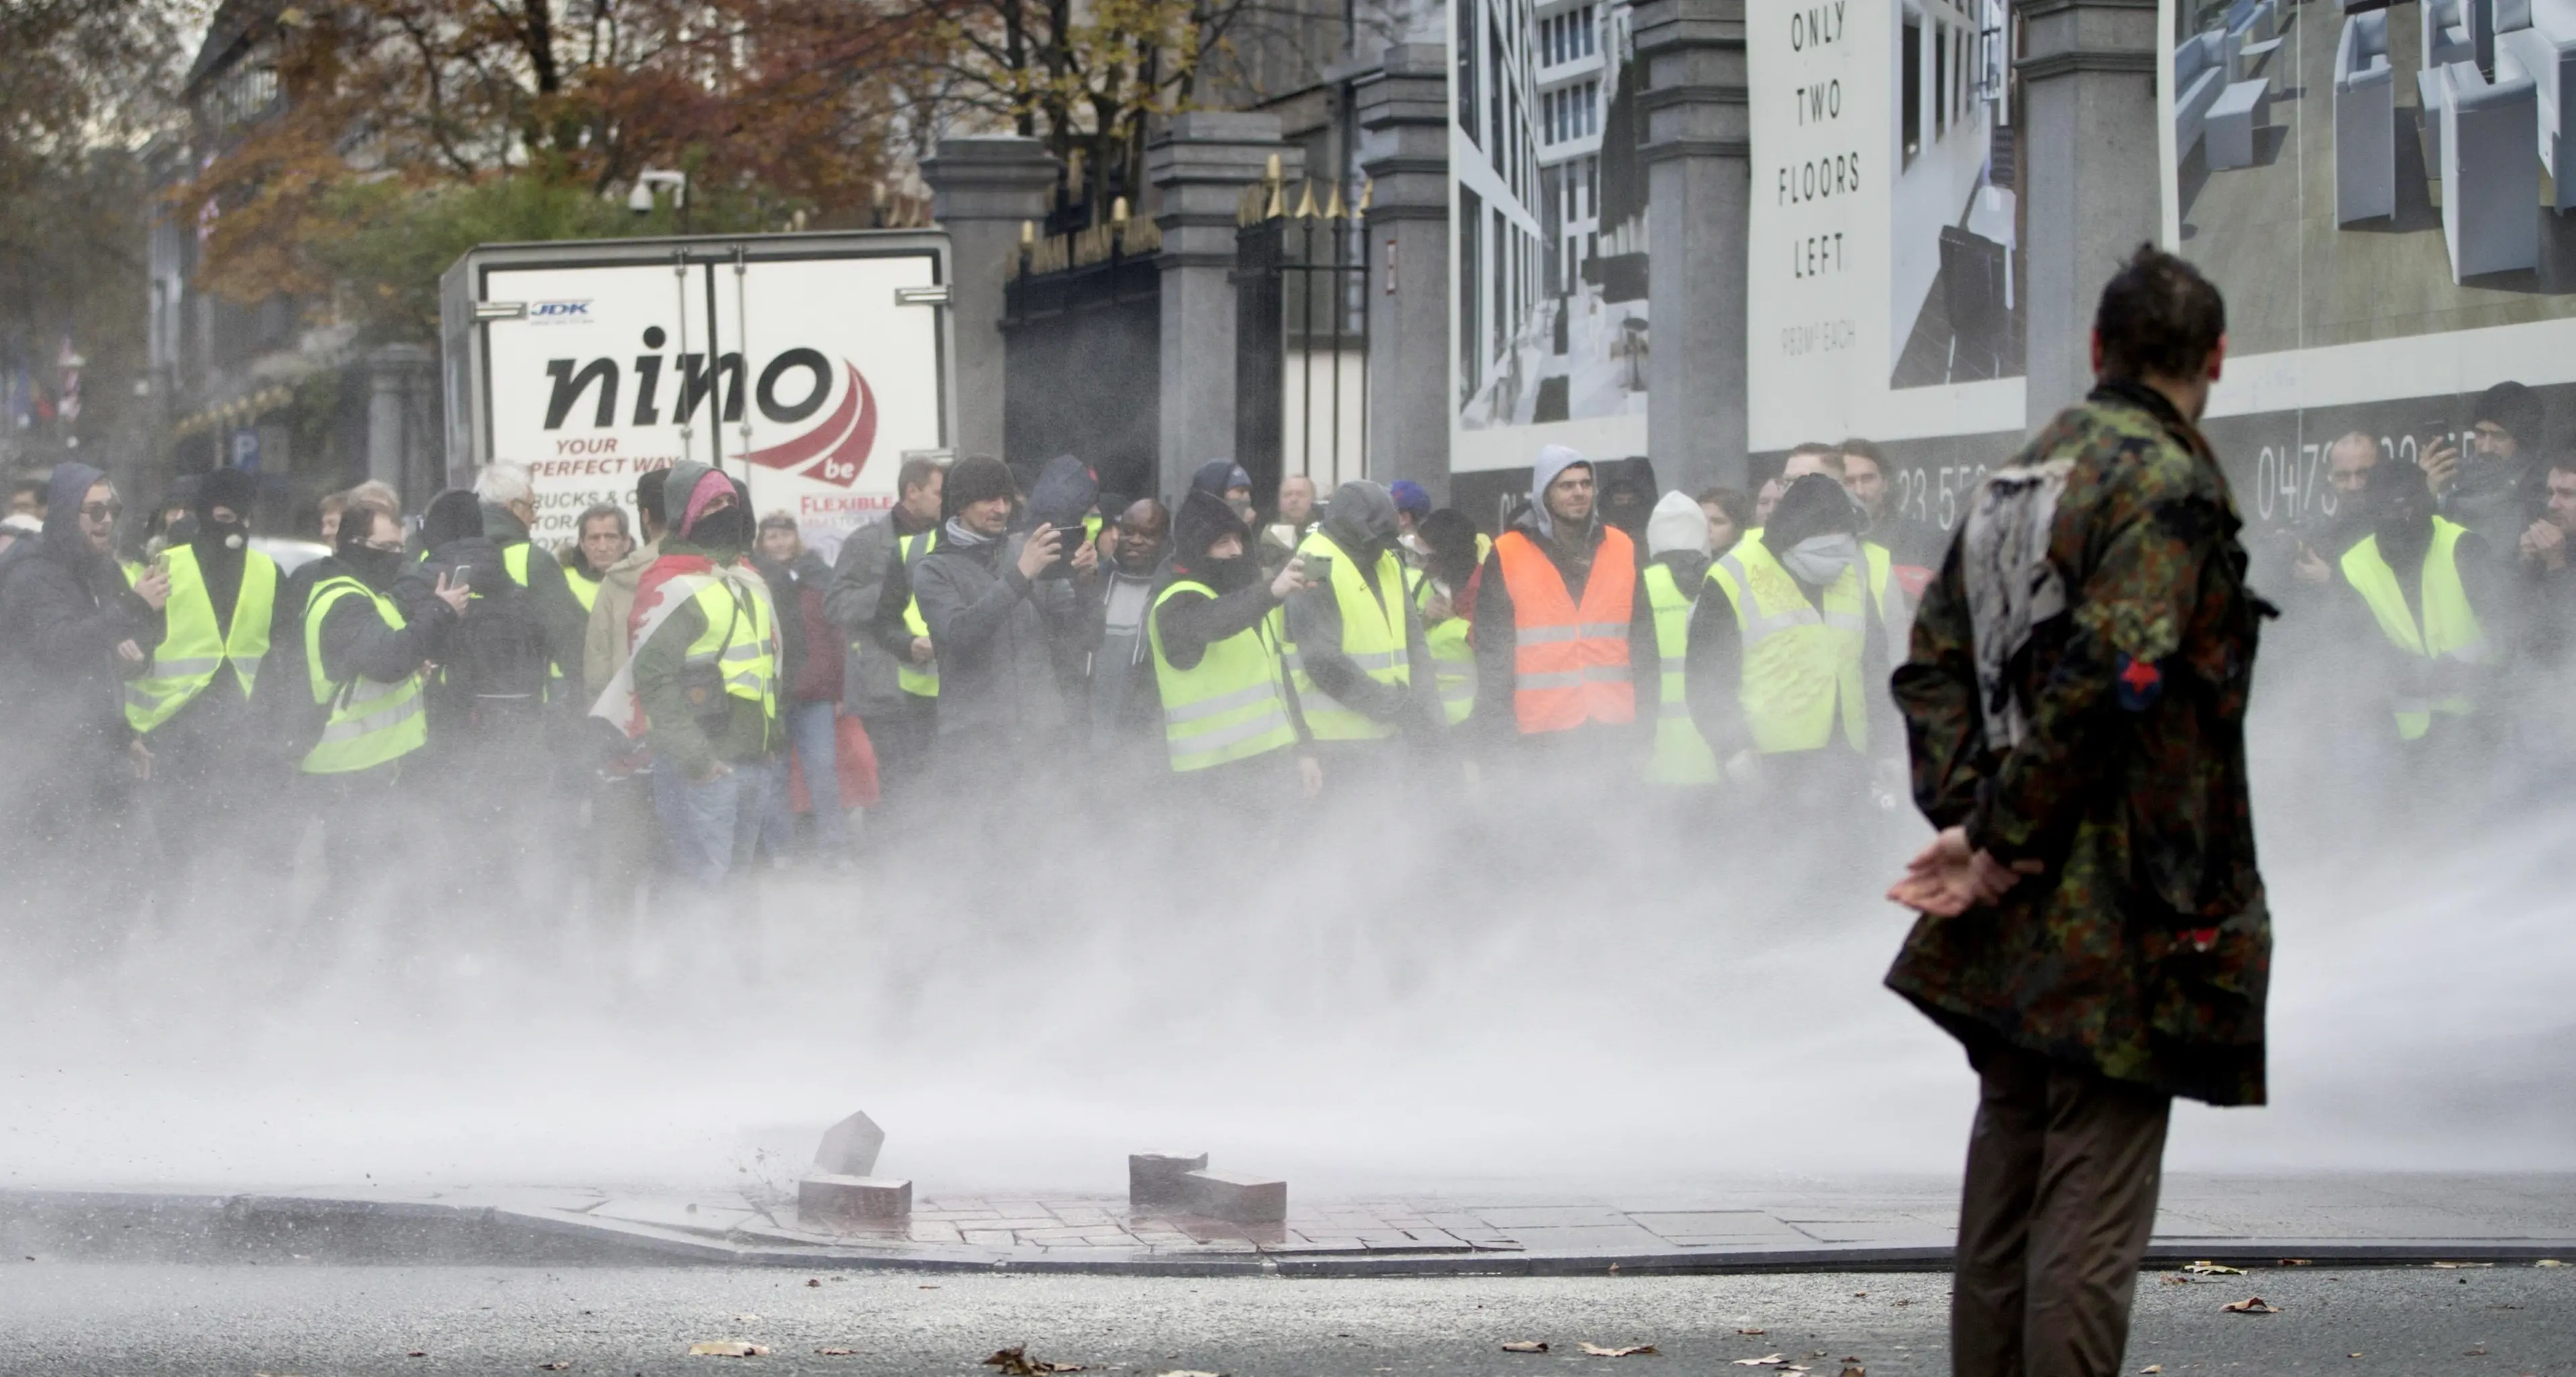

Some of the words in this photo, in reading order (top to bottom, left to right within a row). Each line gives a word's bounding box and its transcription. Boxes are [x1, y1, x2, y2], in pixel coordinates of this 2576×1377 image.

[1791, 0, 1845, 52] ONLY
[1796, 79, 1841, 126] TWO
[1778, 152, 1859, 205] FLOORS
[1794, 233, 1843, 278] LEFT
[531, 303, 589, 315] JDK
[543, 325, 833, 430] nino
[233, 435, 259, 464] P
[556, 438, 619, 455] YOUR
[530, 458, 628, 476] PERFECT
[824, 456, 855, 479] be
[534, 491, 598, 509] RUCKS
[801, 495, 894, 515] FLEXIBLE
